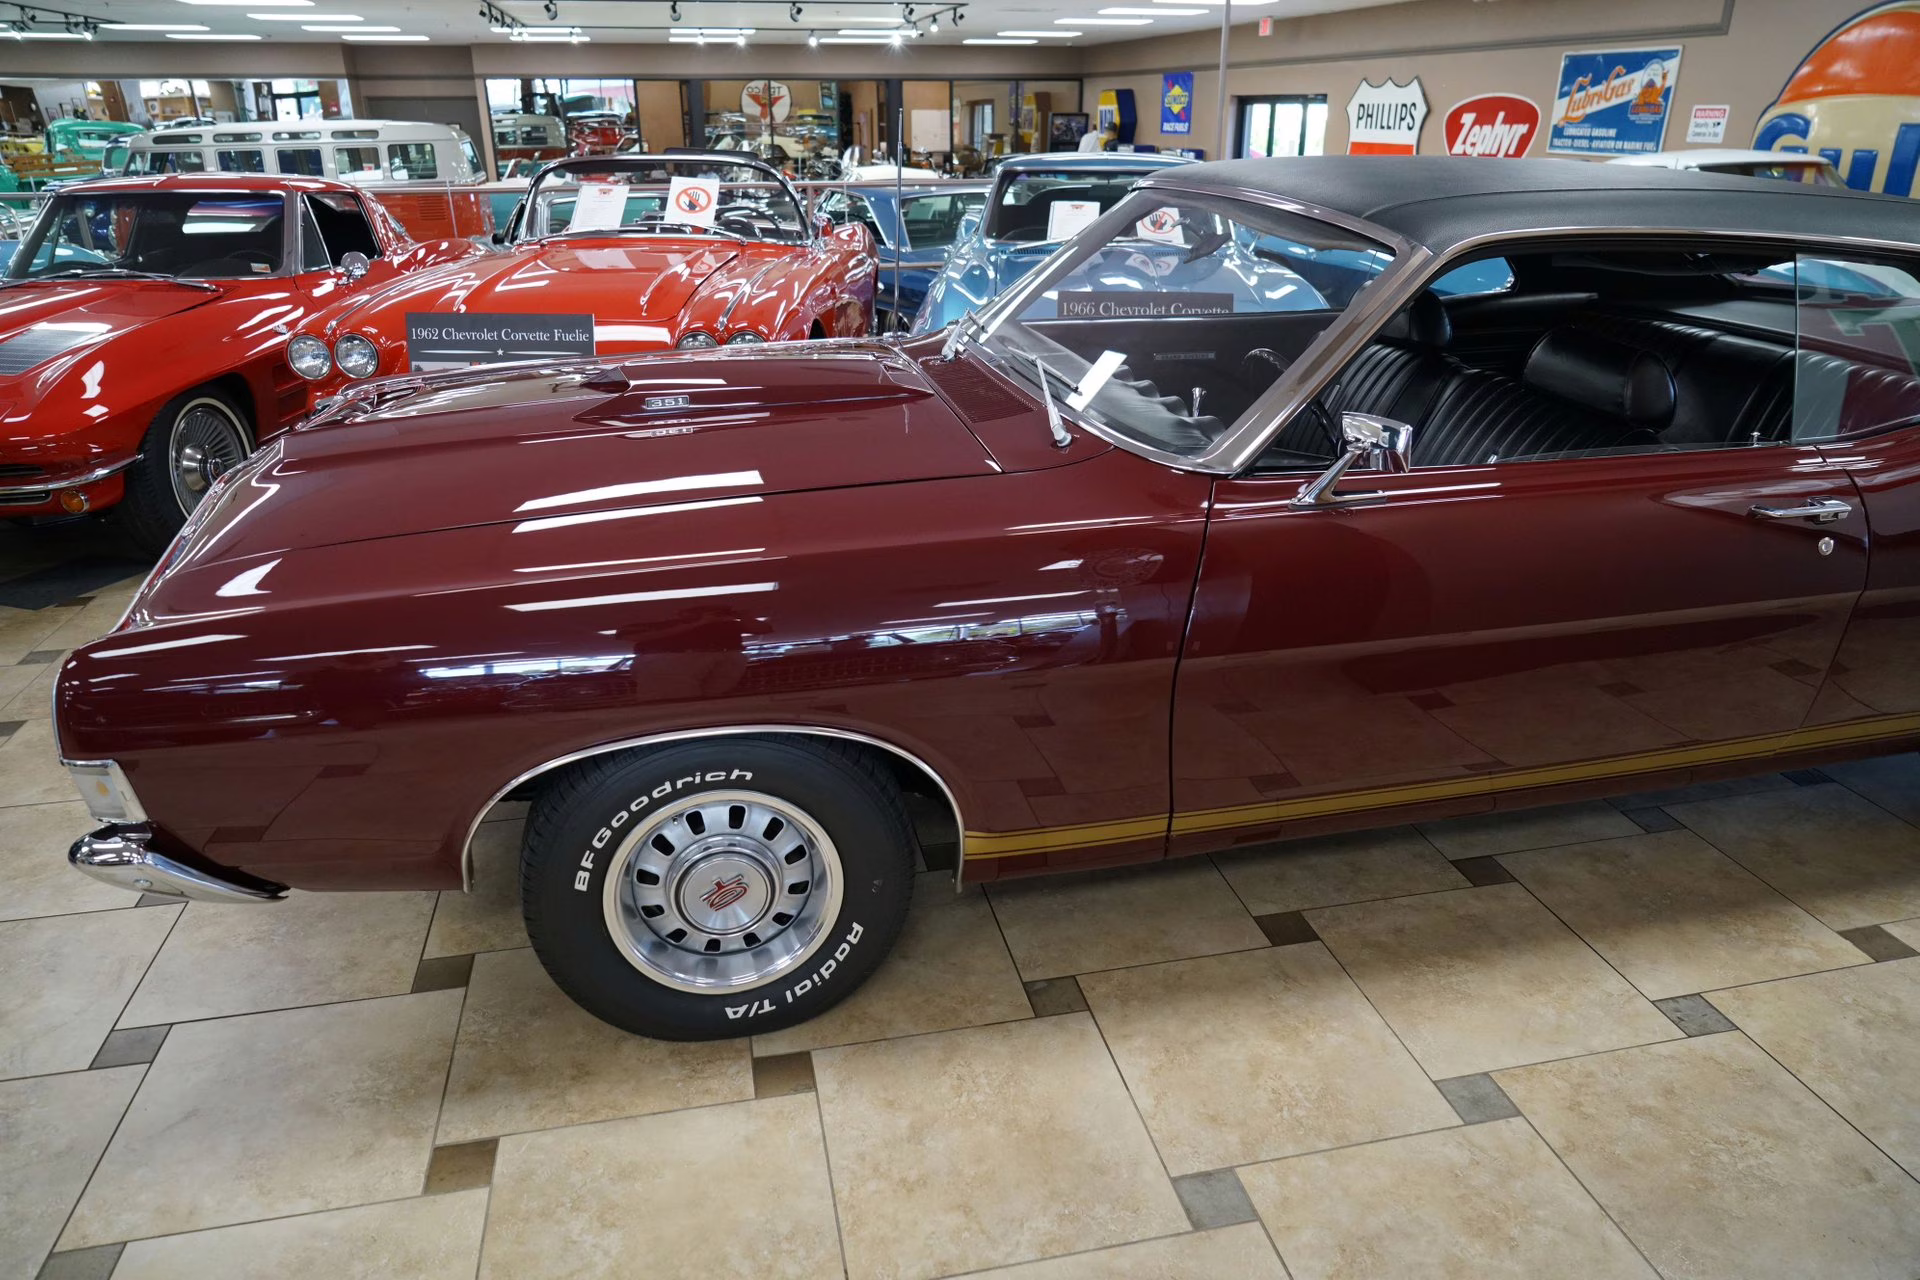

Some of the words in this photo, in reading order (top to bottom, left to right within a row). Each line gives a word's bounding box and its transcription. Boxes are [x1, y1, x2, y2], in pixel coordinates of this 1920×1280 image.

[1356, 102, 1417, 131] PHILLIPS
[1695, 110, 1726, 118] WARNING
[1450, 111, 1530, 158] Zephyr
[1063, 302, 1095, 316] 1966
[1100, 301, 1166, 316] Chevrolet
[1170, 303, 1229, 315] Corvette
[411, 327, 439, 340] 1962
[442, 327, 498, 341] Chevrolet
[501, 328, 550, 341] Corvette
[554, 328, 590, 342] Fuelie
[651, 397, 684, 407] 351
[574, 768, 753, 892] BFGoodrich
[785, 921, 864, 1003] Radial
[724, 998, 777, 1020] T/A
